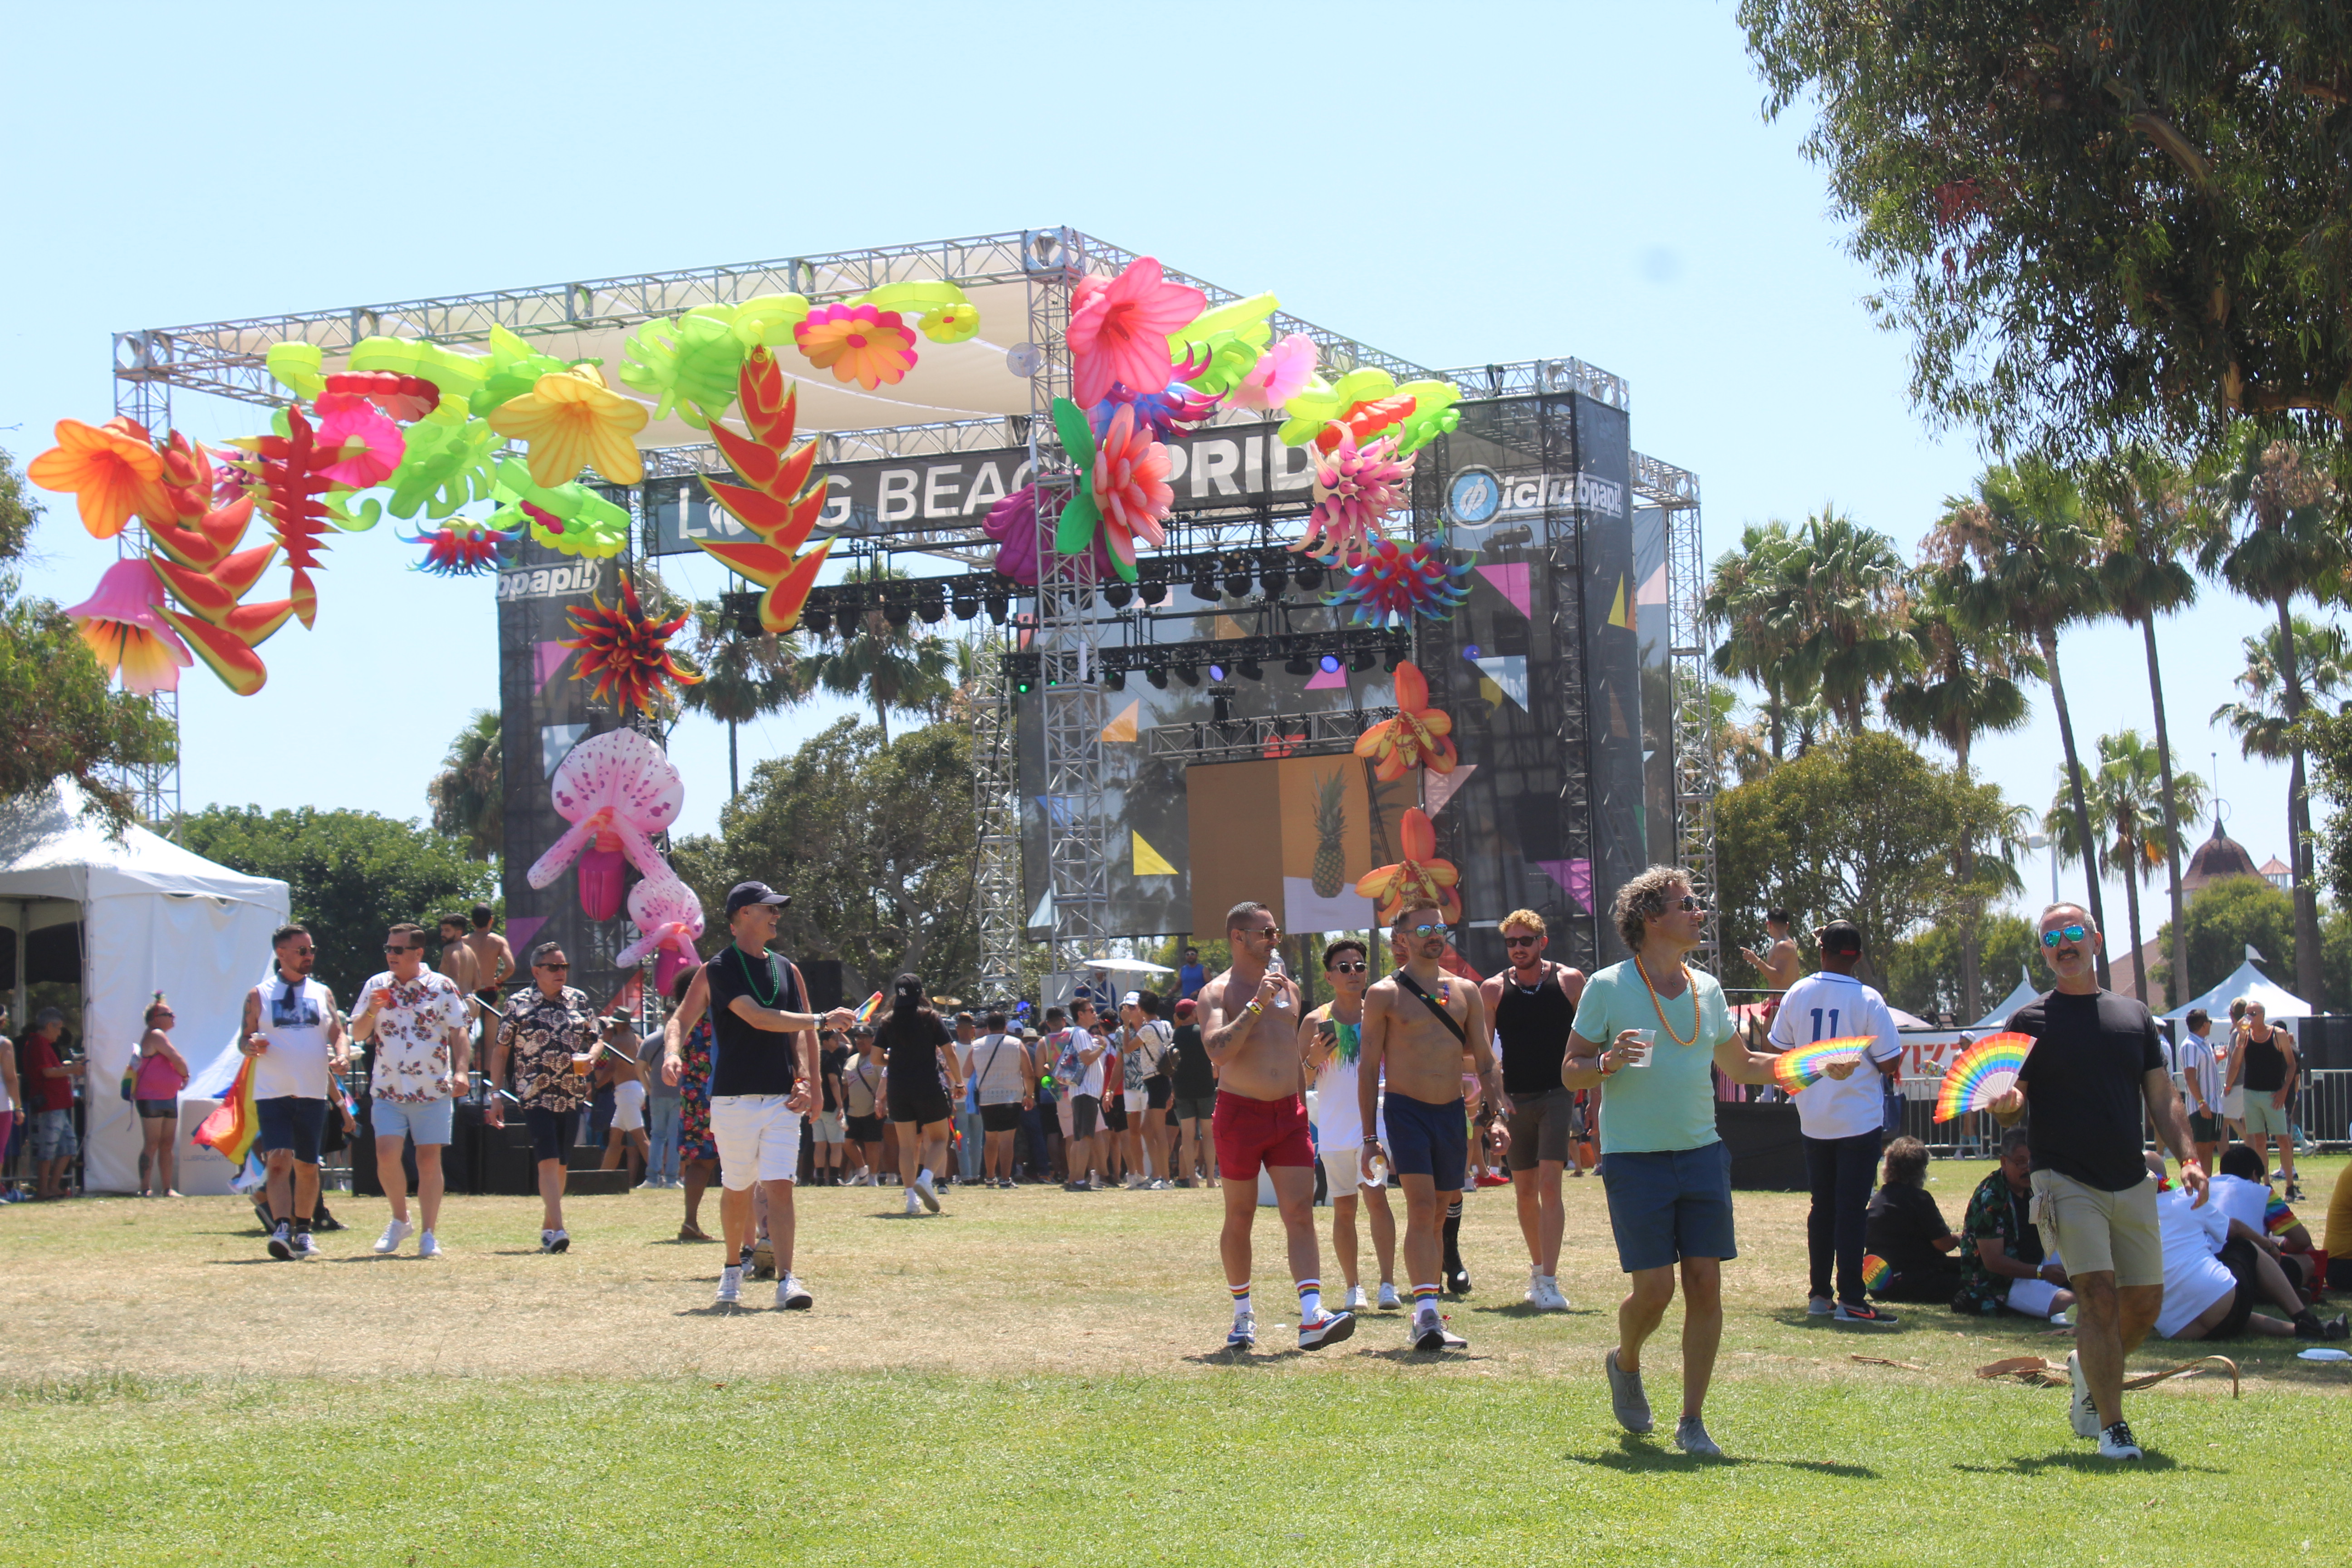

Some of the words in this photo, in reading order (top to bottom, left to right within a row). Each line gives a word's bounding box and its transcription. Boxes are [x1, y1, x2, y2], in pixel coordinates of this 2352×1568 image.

[679, 475, 852, 539] LG
[1809, 1008, 1839, 1043] 11
[1865, 1265, 1882, 1284] LOVE
